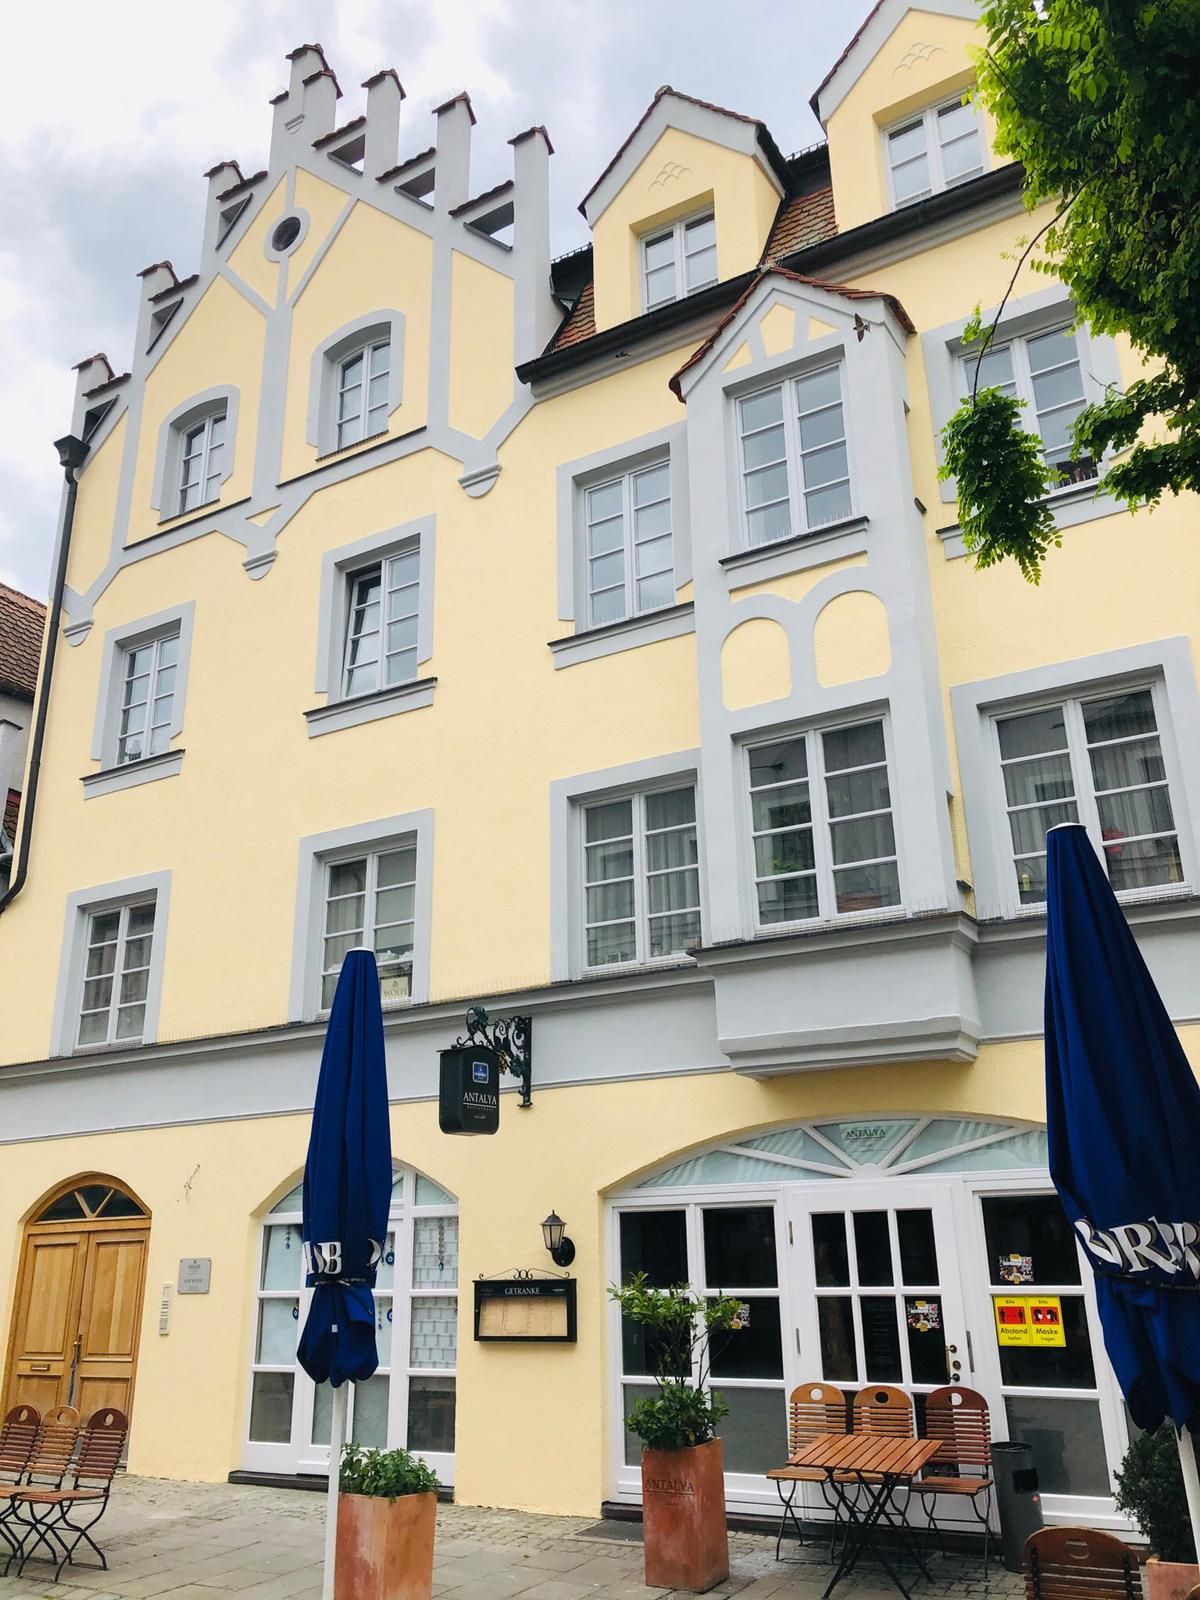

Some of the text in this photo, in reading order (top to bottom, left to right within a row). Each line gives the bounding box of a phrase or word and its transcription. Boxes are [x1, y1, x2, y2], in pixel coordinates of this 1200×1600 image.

[463, 1092, 497, 1105] ANTALYA
[845, 1129, 887, 1138] ANTALYA
[1000, 1327, 1028, 1335] Abstand
[1036, 1327, 1058, 1335] Maske
[646, 1480, 694, 1491] ANTALYA
